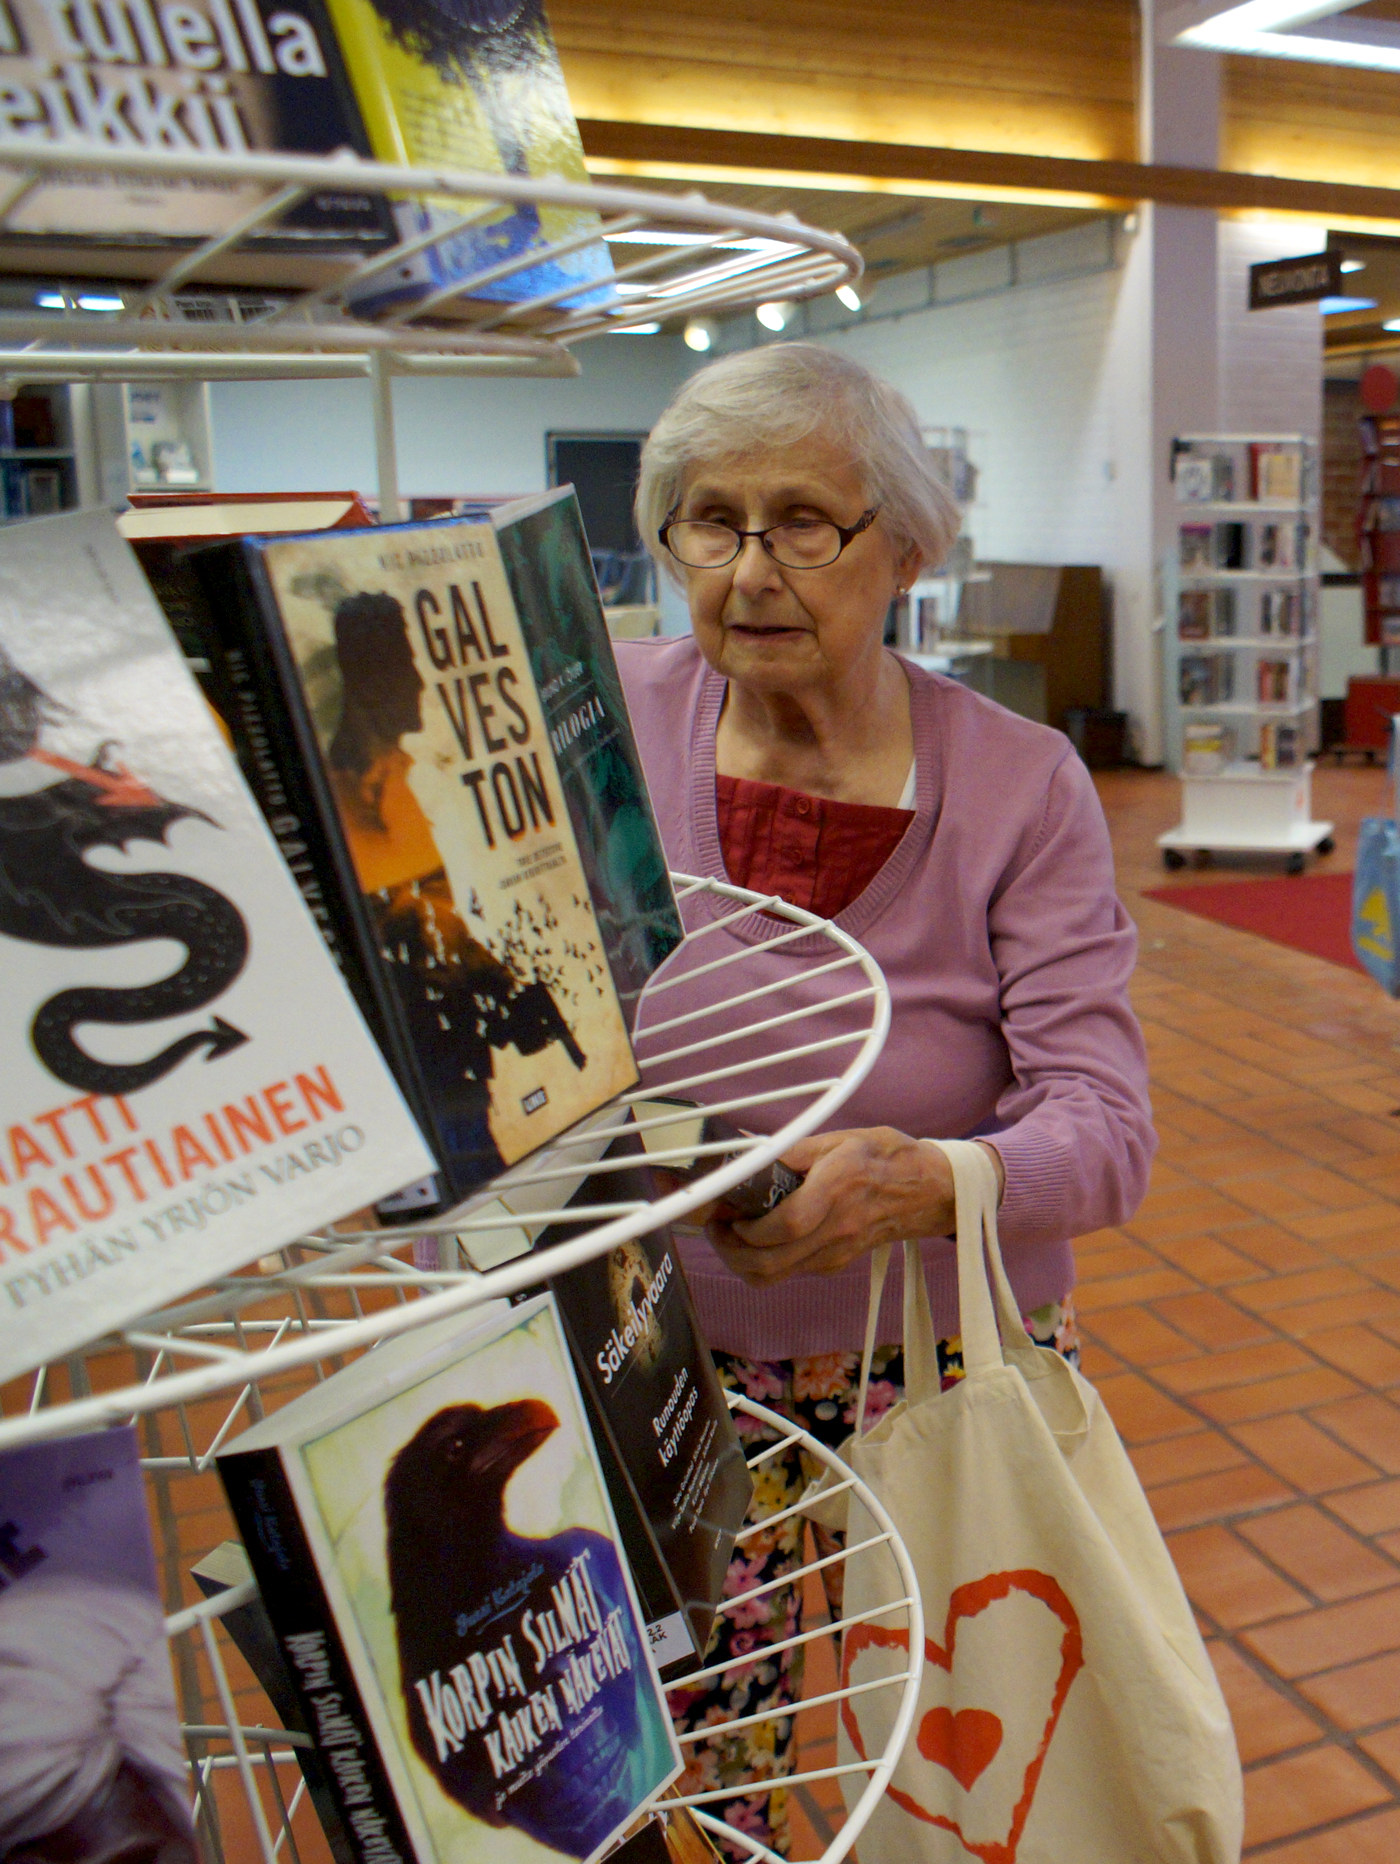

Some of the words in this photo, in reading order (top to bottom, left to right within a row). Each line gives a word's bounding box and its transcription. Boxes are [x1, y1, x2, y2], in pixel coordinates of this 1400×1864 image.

[46, 0, 329, 78] tulella
[0, 58, 251, 153] eikkii
[415, 580, 512, 673] GAL
[436, 666, 532, 761] VES
[461, 751, 558, 851] TON
[0, 1090, 140, 1188] ATTI
[4, 1228, 140, 1309] PYHÄN
[140, 1172, 259, 1242] YRJÖN
[259, 1124, 367, 1187] VARJO
[596, 1251, 674, 1385] Säkeilyvaara
[651, 1366, 690, 1438] Runouden
[657, 1385, 700, 1468] käyttöopas
[413, 1633, 528, 1764] KORPIN
[520, 1547, 602, 1675] SILMÄT
[483, 1682, 564, 1780] KAIKEN
